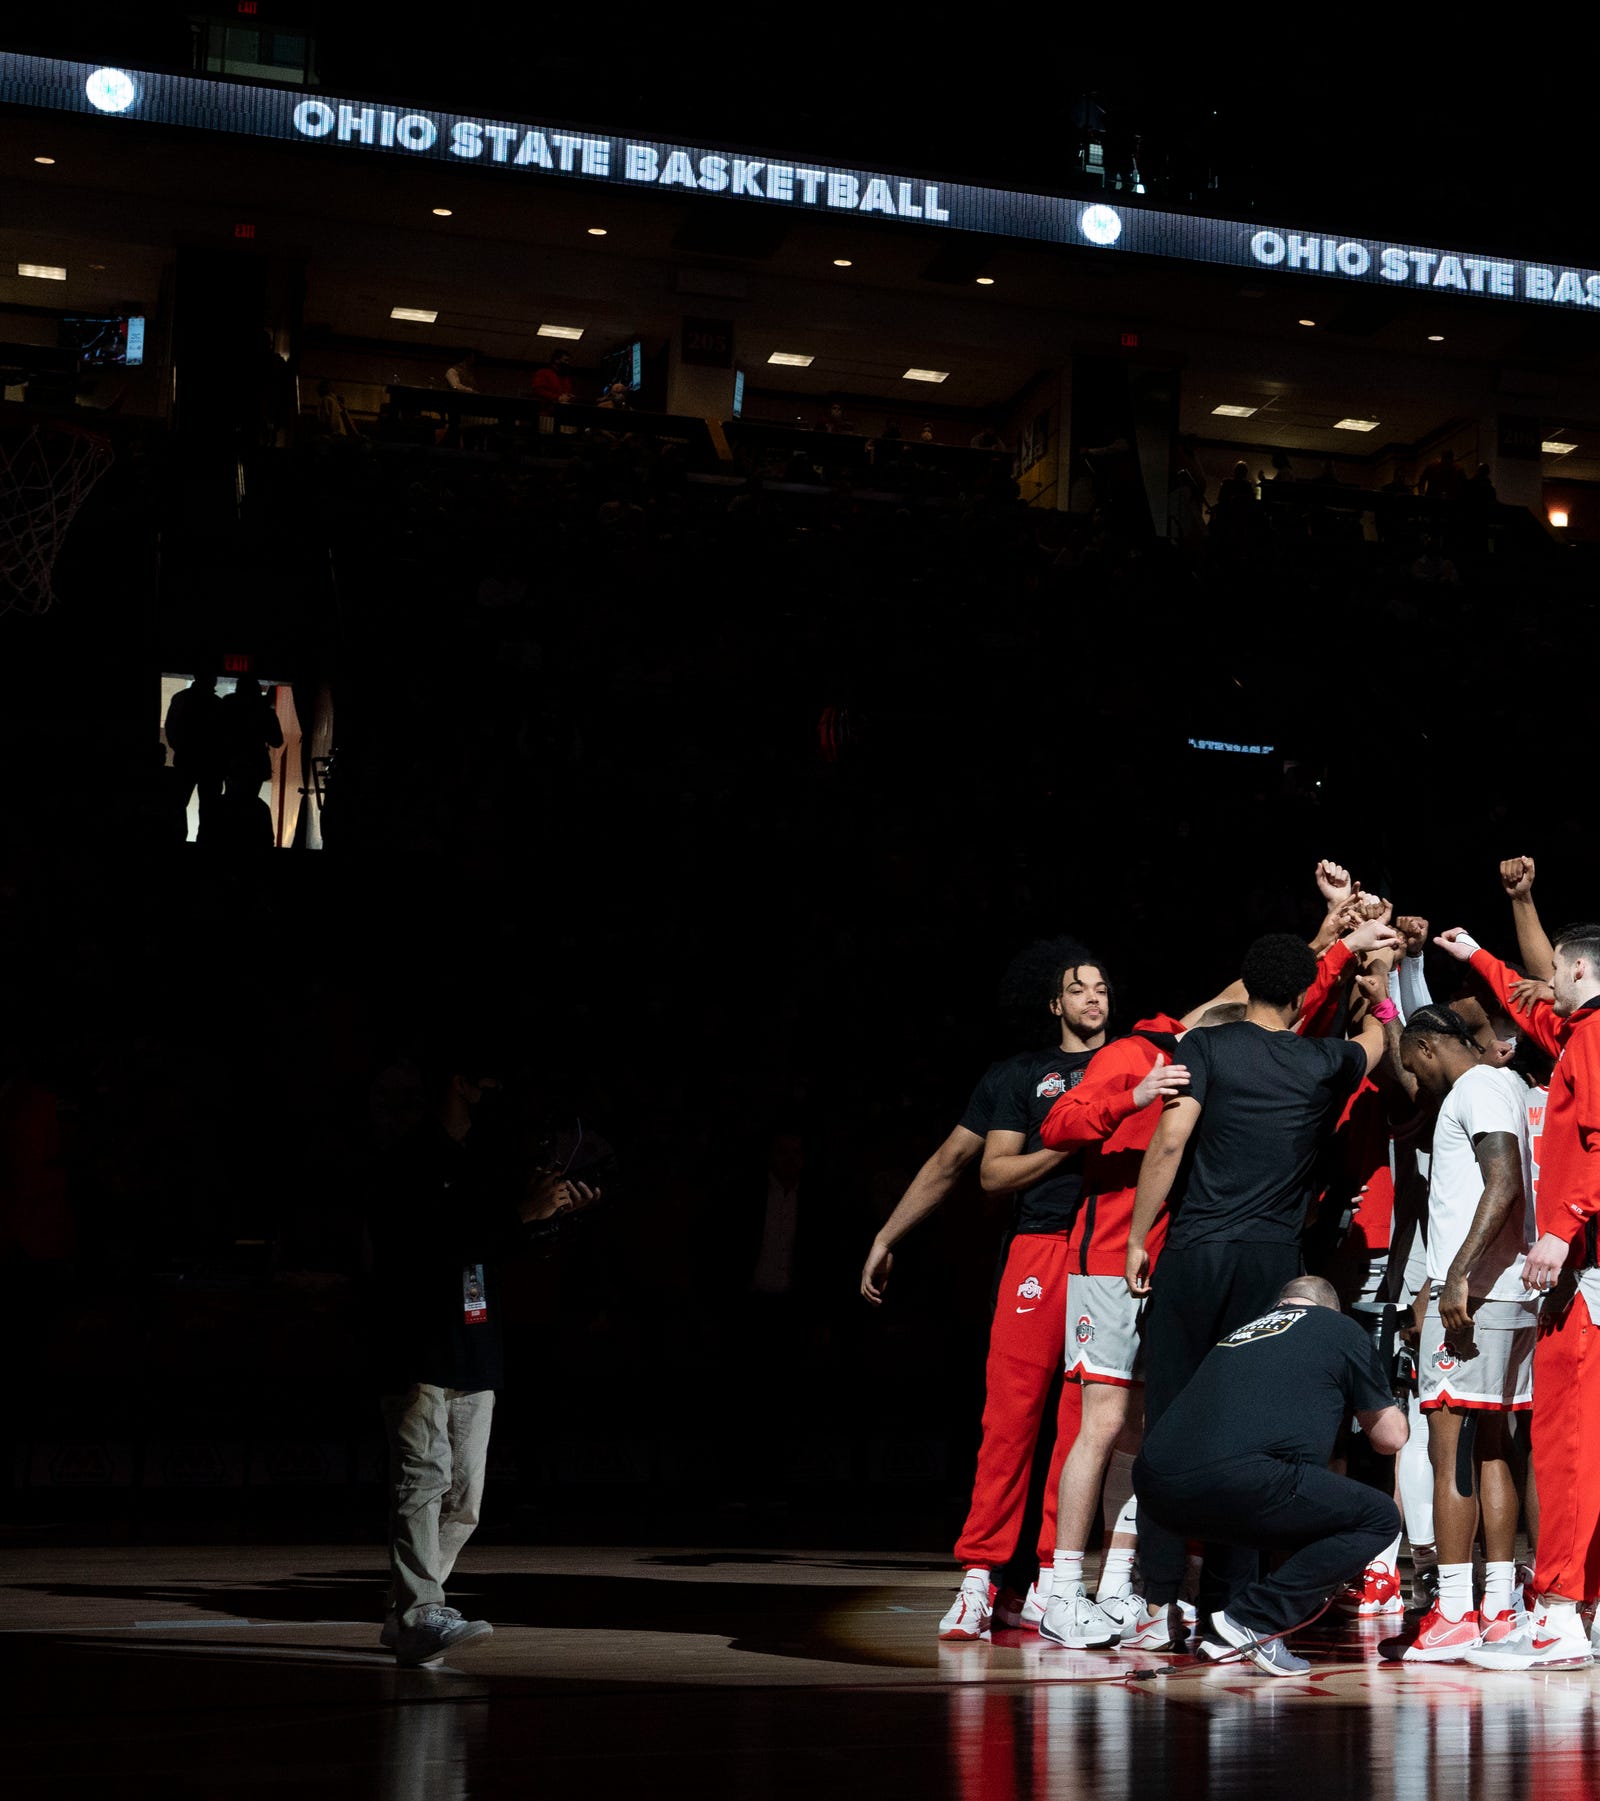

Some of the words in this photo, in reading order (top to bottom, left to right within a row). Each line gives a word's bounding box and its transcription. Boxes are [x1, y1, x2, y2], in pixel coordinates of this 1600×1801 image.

[293, 99, 437, 151] OHIO
[450, 121, 611, 176] STATE
[625, 144, 951, 223] BASKETBALL
[234, 224, 257, 240] EXIT
[1250, 230, 1371, 277] OHIO
[1379, 247, 1516, 297] STATE
[688, 328, 728, 354] 205
